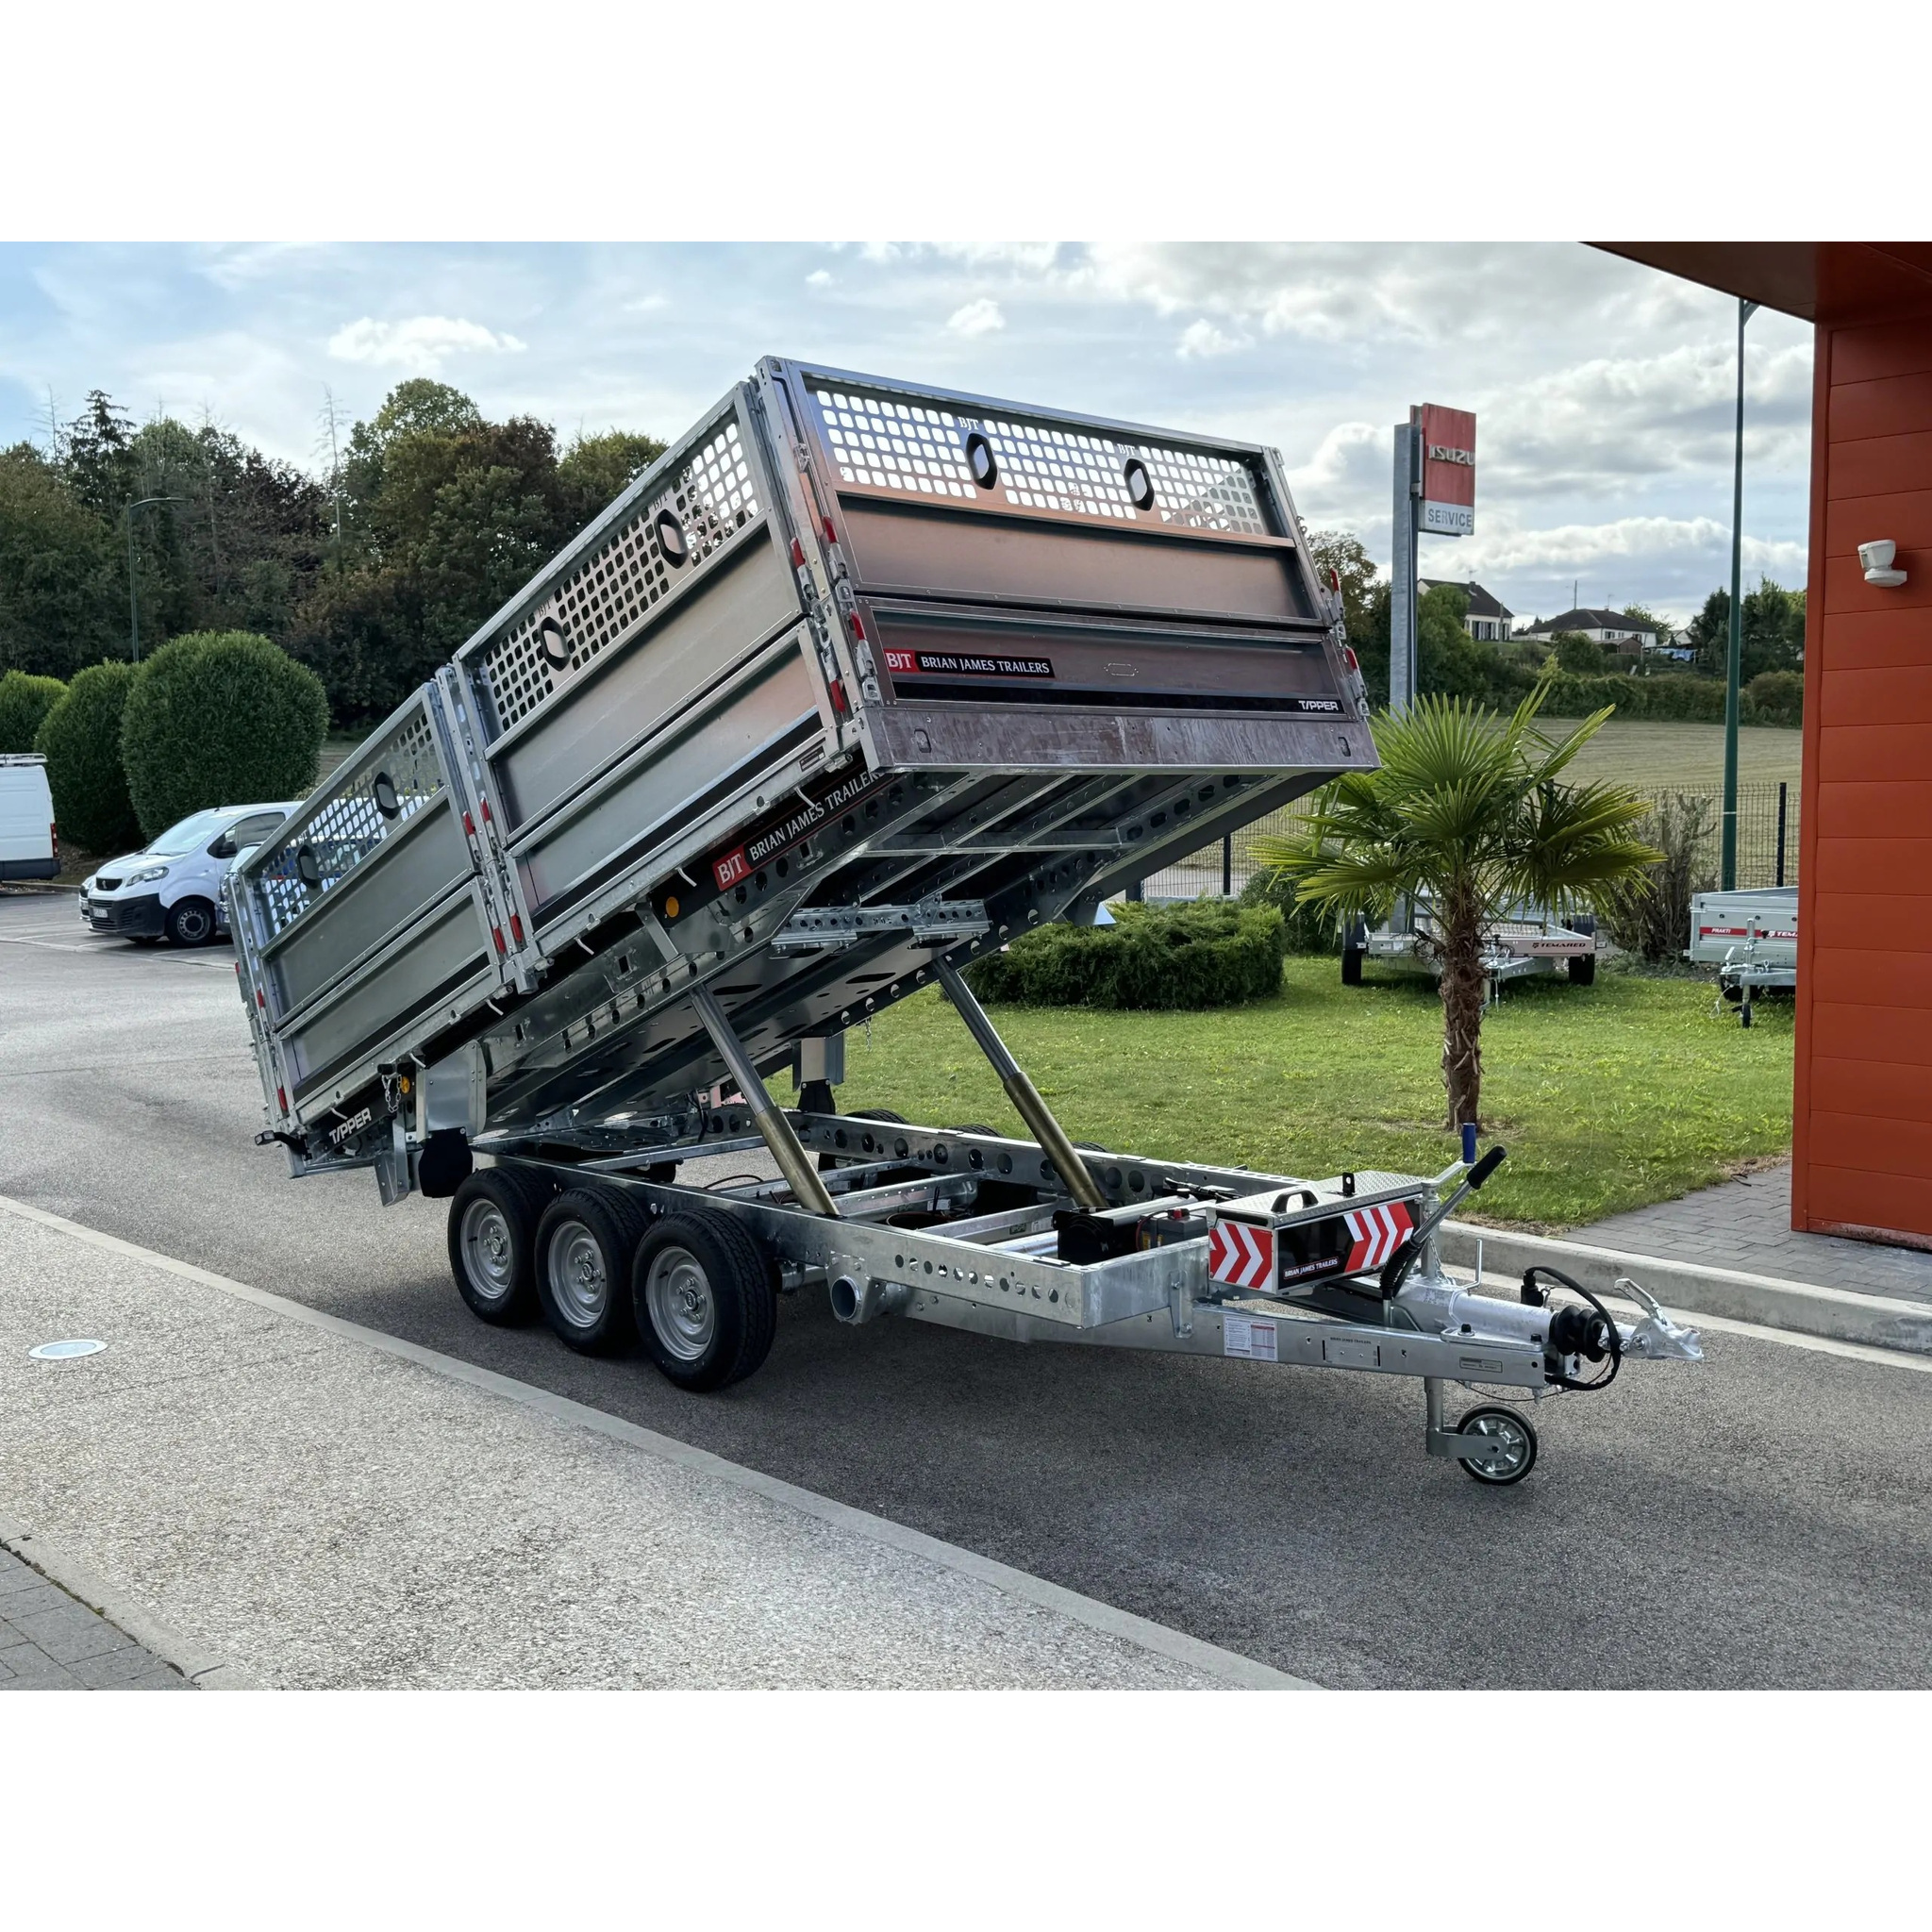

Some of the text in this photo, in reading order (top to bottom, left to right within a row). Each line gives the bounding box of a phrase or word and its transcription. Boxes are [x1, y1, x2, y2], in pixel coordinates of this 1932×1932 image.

[958, 416, 979, 431] BJT
[1117, 443, 1137, 457] BJT
[1428, 444, 1474, 466] ISUZU
[1427, 508, 1473, 527] SERVICE
[885, 652, 1051, 674] BJT BRIAN JAMES TRAILERS
[717, 853, 743, 885] BJT
[749, 826, 787, 861] BRIAN
[788, 801, 826, 841] JAMES
[1284, 1258, 1338, 1277] BRIAN JAMES TRAILERS
